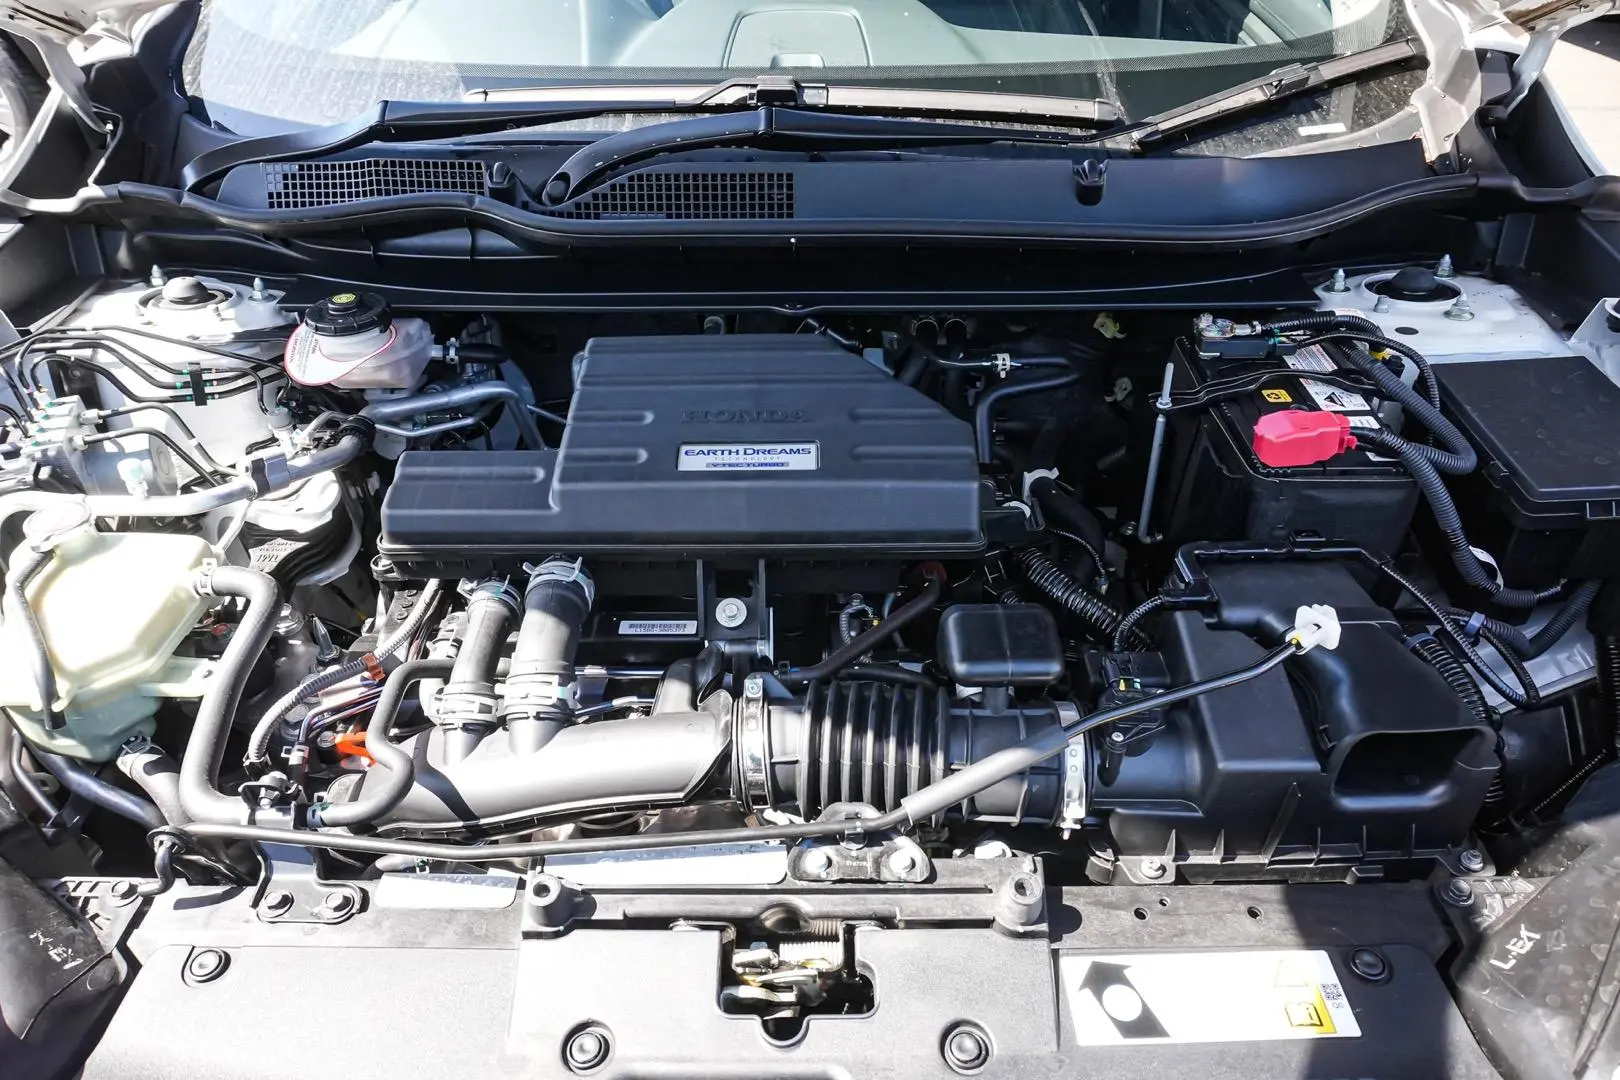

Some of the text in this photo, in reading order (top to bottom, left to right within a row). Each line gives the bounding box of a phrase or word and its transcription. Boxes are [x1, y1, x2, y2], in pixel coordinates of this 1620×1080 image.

[681, 407, 814, 424] HONDA
[684, 448, 812, 457] EARTH DREAMS
